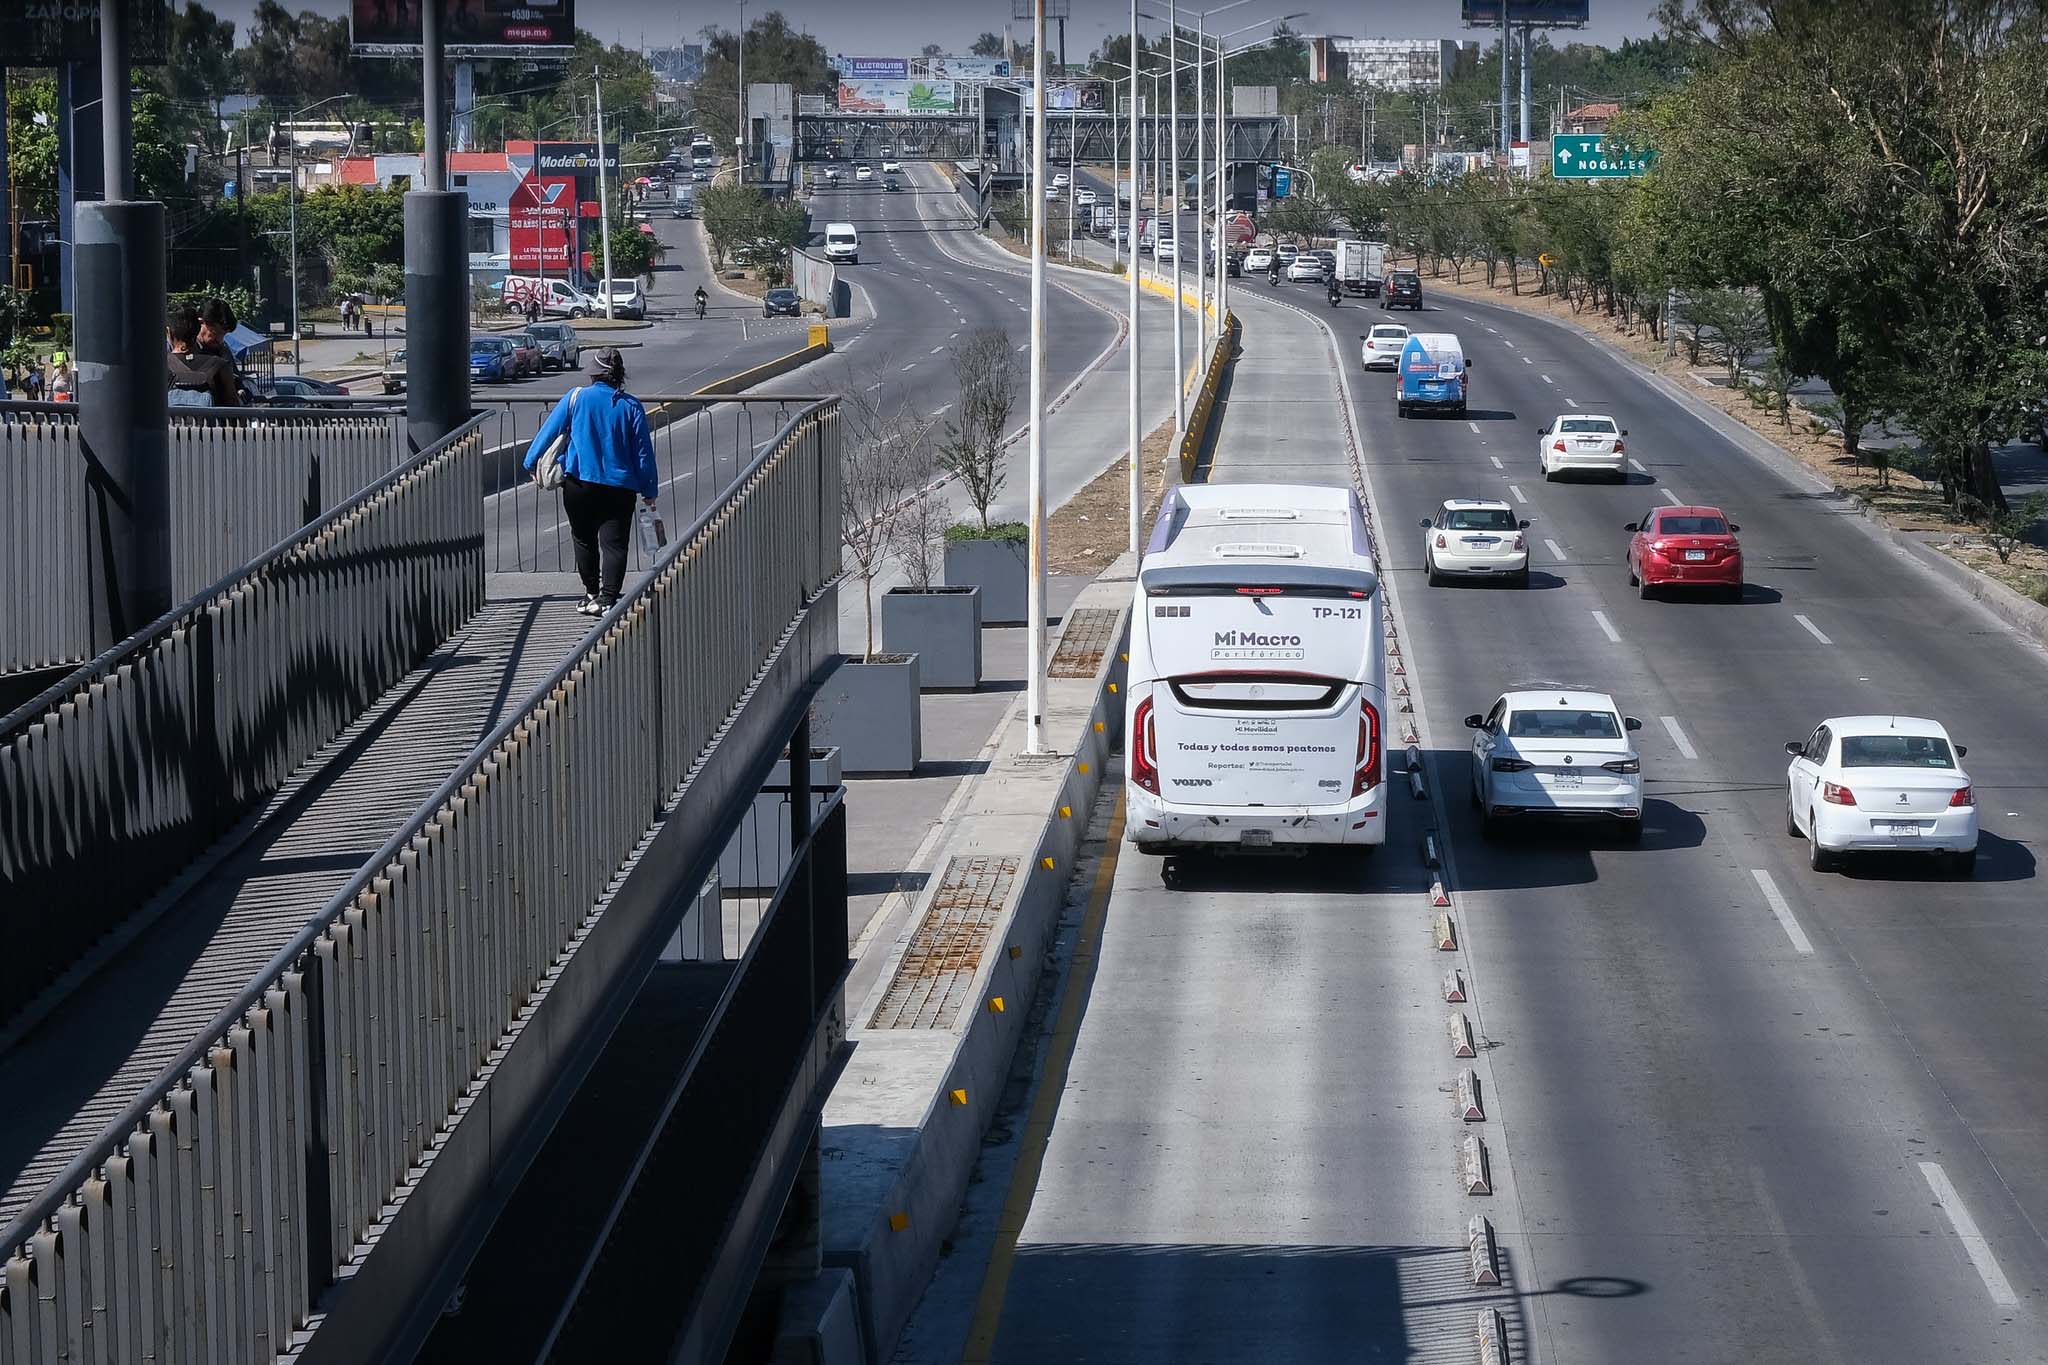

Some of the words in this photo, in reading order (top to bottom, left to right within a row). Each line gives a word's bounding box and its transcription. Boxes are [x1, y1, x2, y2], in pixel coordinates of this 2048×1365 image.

[507, 29, 548, 38] mega.mx
[855, 62, 903, 70] ELECTROLITOS
[1578, 160, 1646, 170] NOGALES
[1312, 607, 1362, 620] TP-121
[1214, 630, 1237, 646] Mi
[1240, 631, 1301, 646] Macro
[1177, 742, 1209, 752] Todas
[1211, 744, 1218, 753] y
[1219, 743, 1250, 752] todos
[1287, 744, 1336, 754] peatones
[1208, 762, 1245, 770] Reportes:
[1172, 778, 1213, 787] VOLVO
